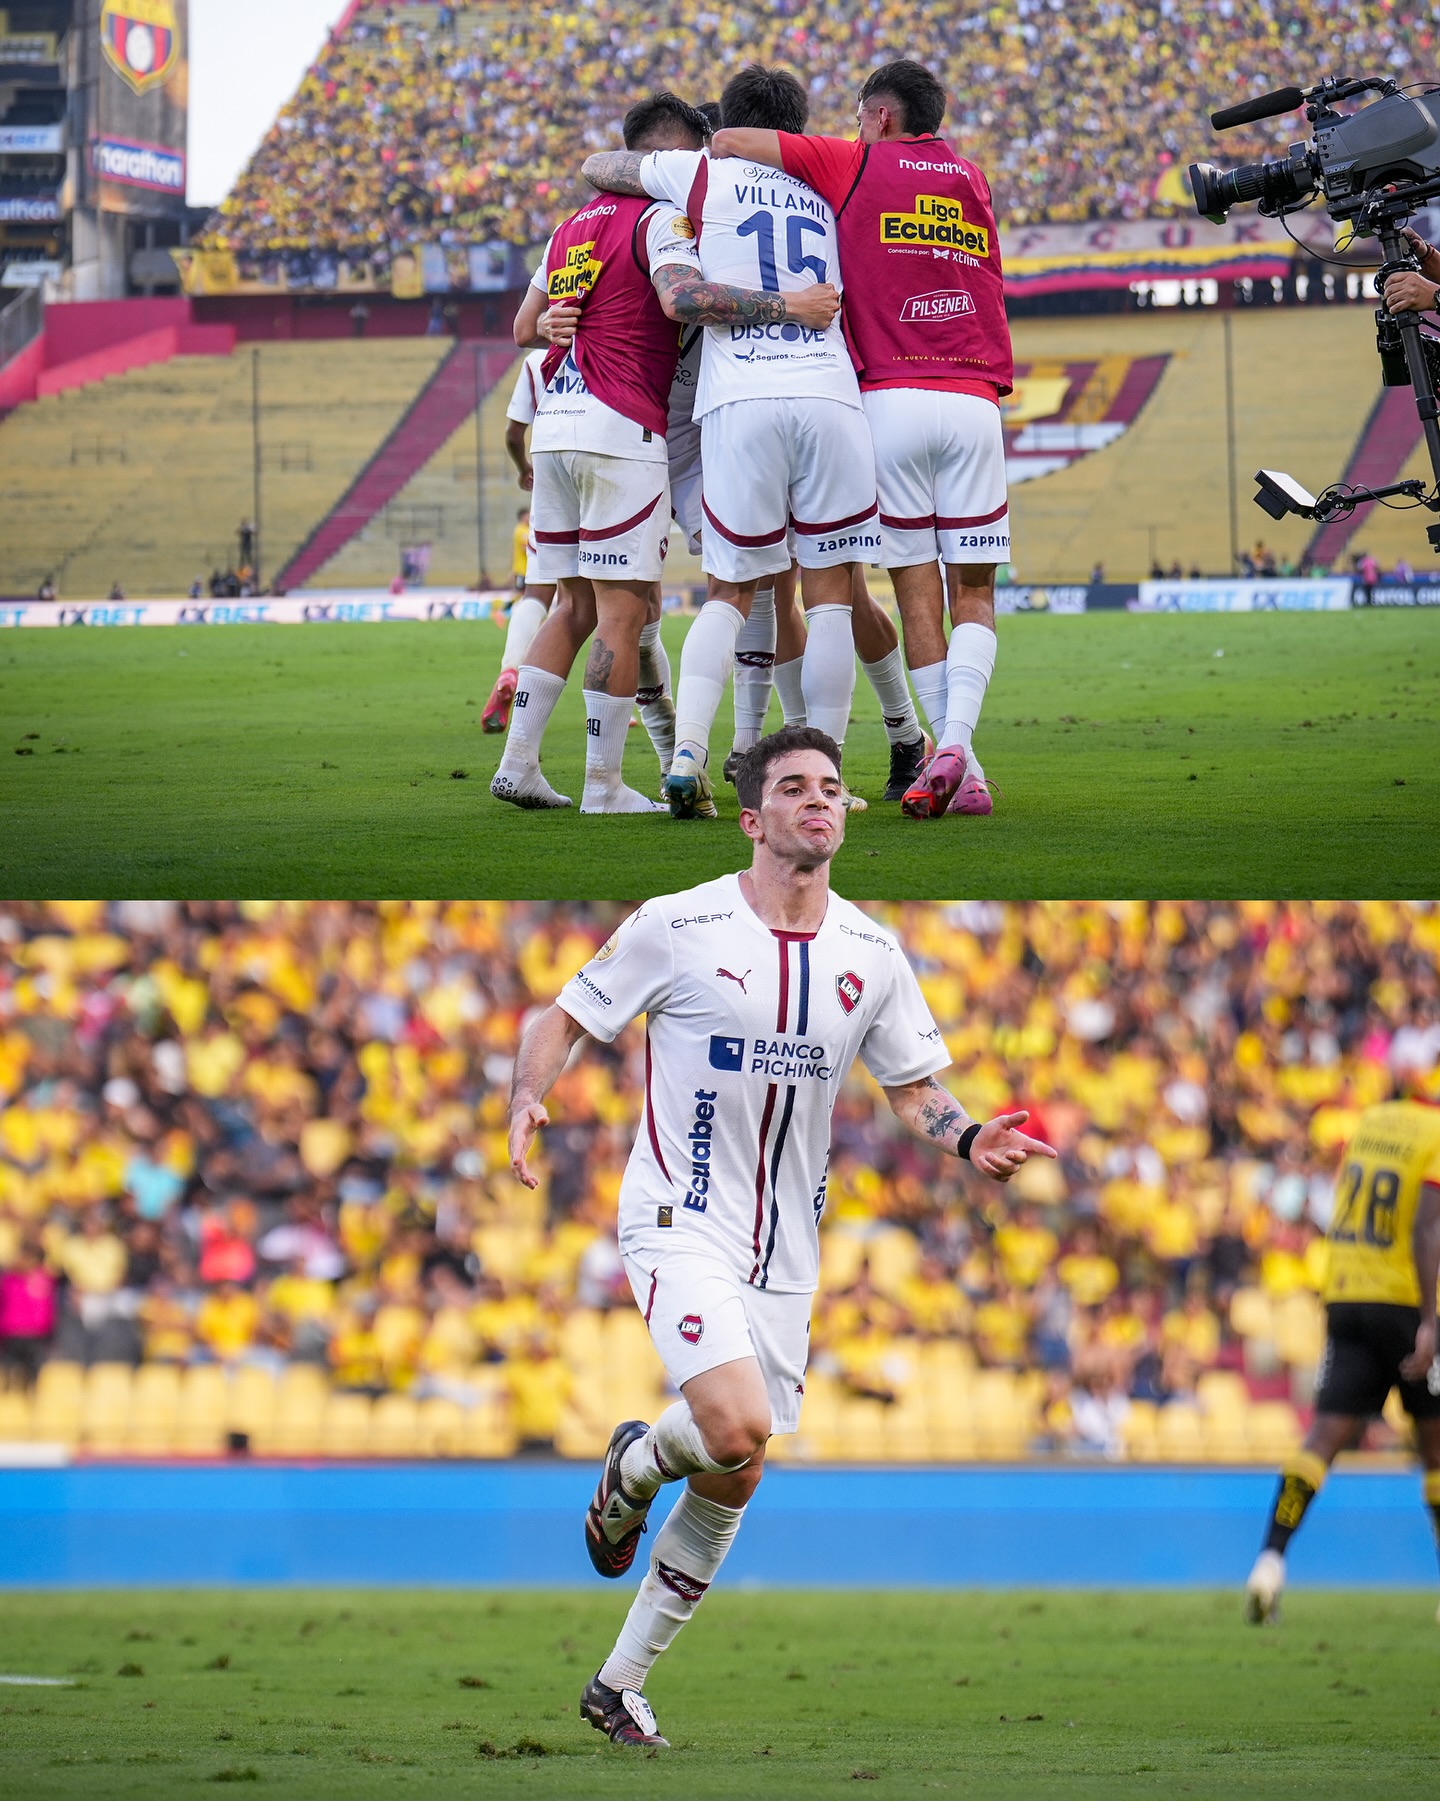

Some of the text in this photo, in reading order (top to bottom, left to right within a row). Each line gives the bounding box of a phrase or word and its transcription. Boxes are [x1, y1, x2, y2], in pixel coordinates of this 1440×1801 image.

[734, 184, 829, 224] VILLAMIL
[919, 198, 960, 222] Liga
[883, 216, 987, 253] Ecuabet
[736, 209, 827, 292] 15
[911, 295, 970, 318] PILSENER
[755, 353, 789, 361] Seguros
[671, 911, 734, 929] CHERY
[839, 924, 895, 952] CHERY
[841, 977, 860, 1001] LDU
[753, 1039, 825, 1060] BANCO
[683, 1088, 717, 1214] Ecuabet
[1333, 1161, 1401, 1248] 28
